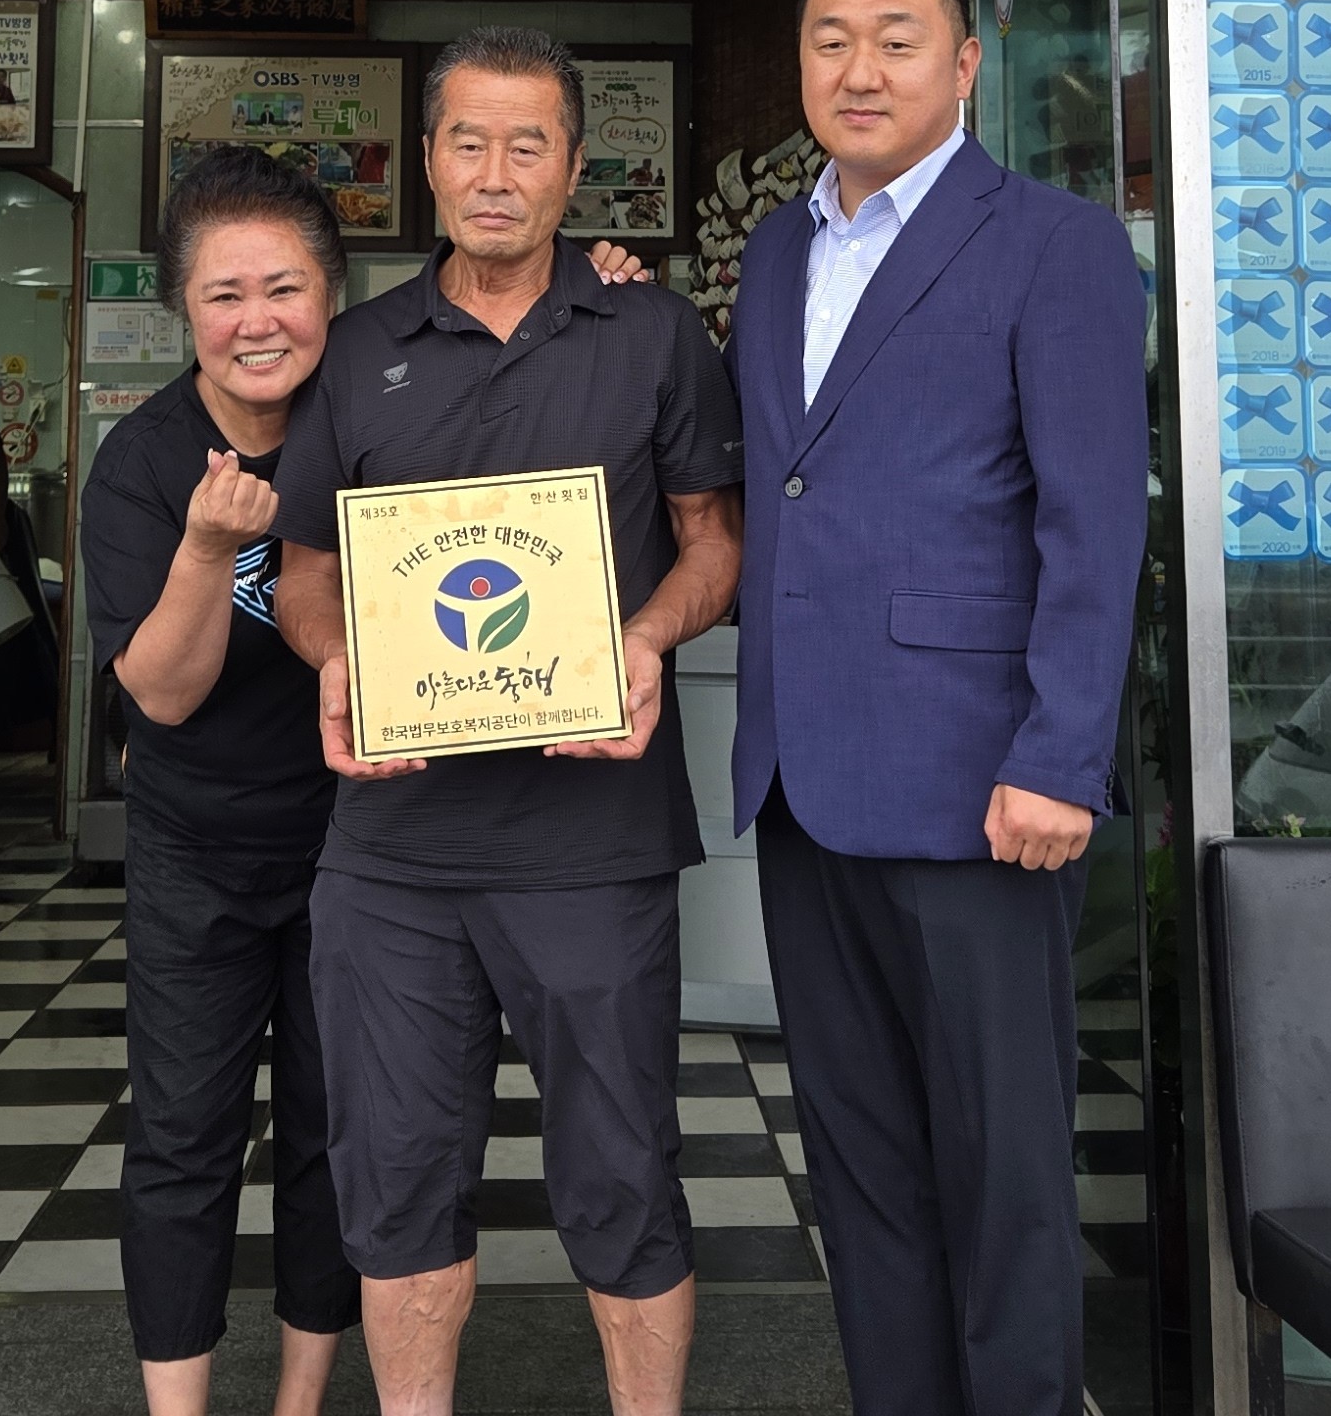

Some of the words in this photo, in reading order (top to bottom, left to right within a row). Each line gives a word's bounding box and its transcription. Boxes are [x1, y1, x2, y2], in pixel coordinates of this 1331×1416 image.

[1243, 69, 1272, 81] 2015
[309, 107, 378, 135] 투데이
[1249, 255, 1277, 266] 2017
[1251, 350, 1280, 362] 2018
[1258, 445, 1287, 457] 2019
[359, 505, 399, 520] 제35호
[391, 542, 433, 578] THE
[433, 524, 489, 553] 안전한
[494, 525, 564, 567] 대한민국
[1261, 541, 1291, 553] 2020
[416, 669, 494, 711] 아름다운
[494, 651, 560, 704] 동행
[380, 712, 532, 742] 한국법무보호복지공단이
[535, 705, 604, 726] 함께합니다.
